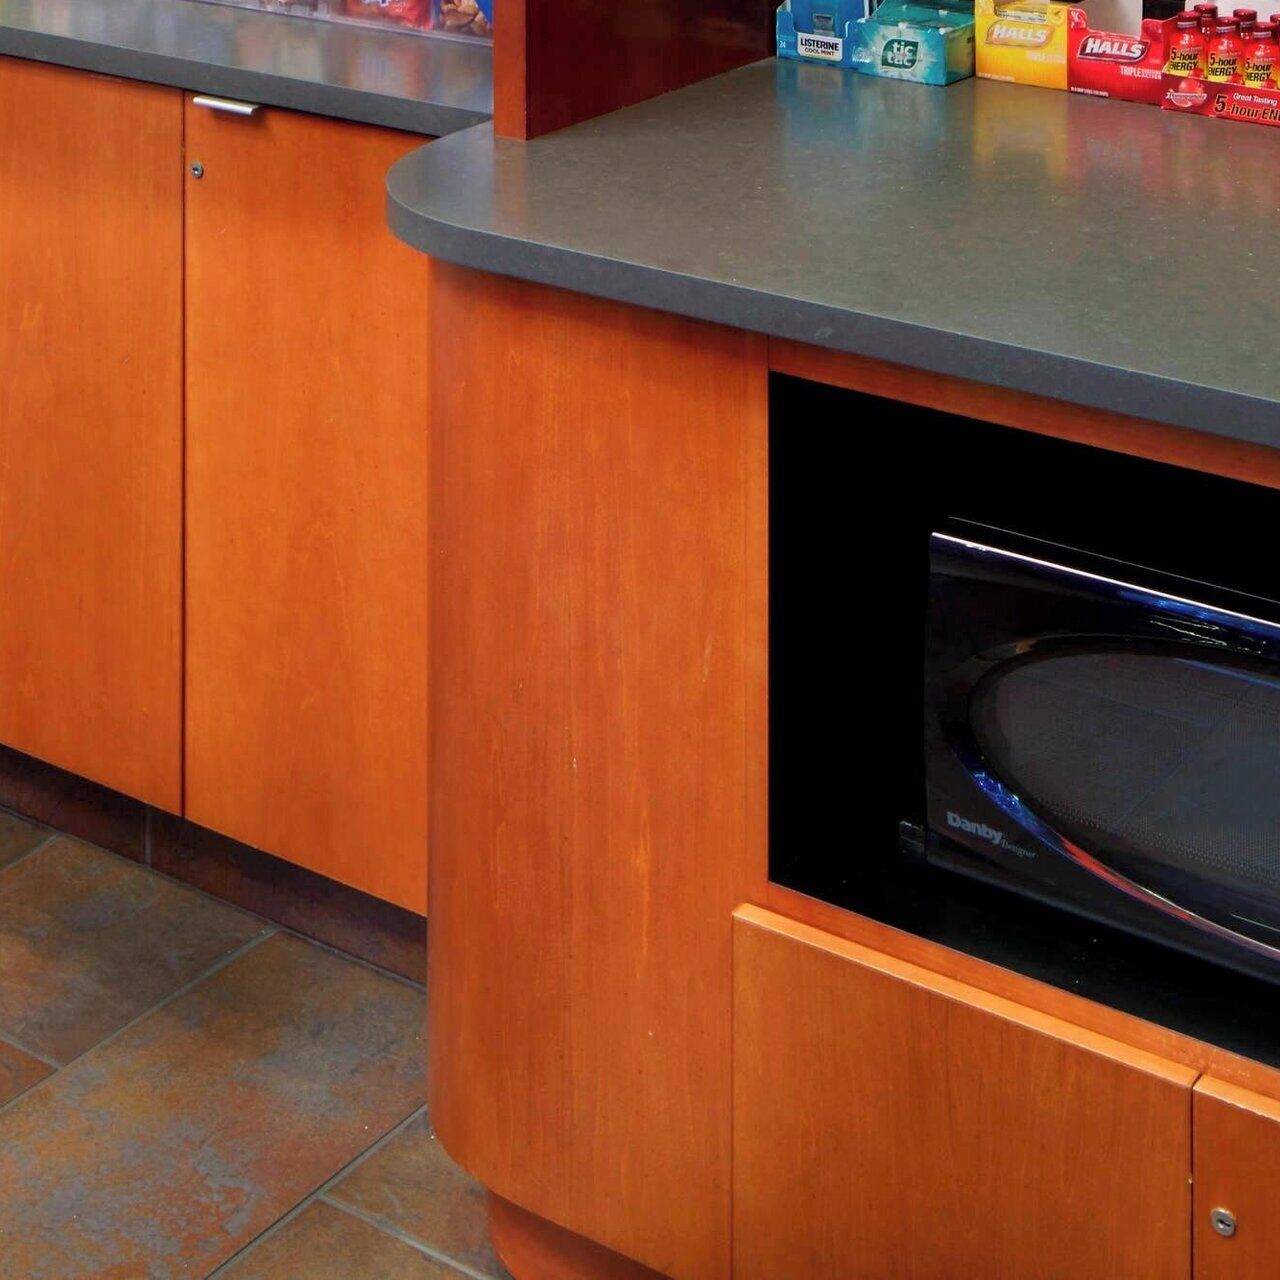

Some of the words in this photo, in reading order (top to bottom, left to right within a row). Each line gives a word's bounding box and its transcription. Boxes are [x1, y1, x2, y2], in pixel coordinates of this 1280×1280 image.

[992, 24, 1048, 43] HALLS
[800, 37, 840, 51] LISTERINE
[892, 41, 914, 56] tic
[1085, 37, 1143, 59] HALLS
[805, 47, 820, 55] COOL
[821, 49, 835, 57] MINT
[886, 50, 913, 67] tac
[1171, 47, 1198, 61] 5-hour
[1210, 52, 1237, 67] 5-hour
[1245, 58, 1273, 72] 5-hour
[1214, 94, 1260, 118] 5-hour
[1233, 92, 1252, 102] Great
[1253, 95, 1278, 107] Tasting
[947, 811, 1003, 845] Danby
